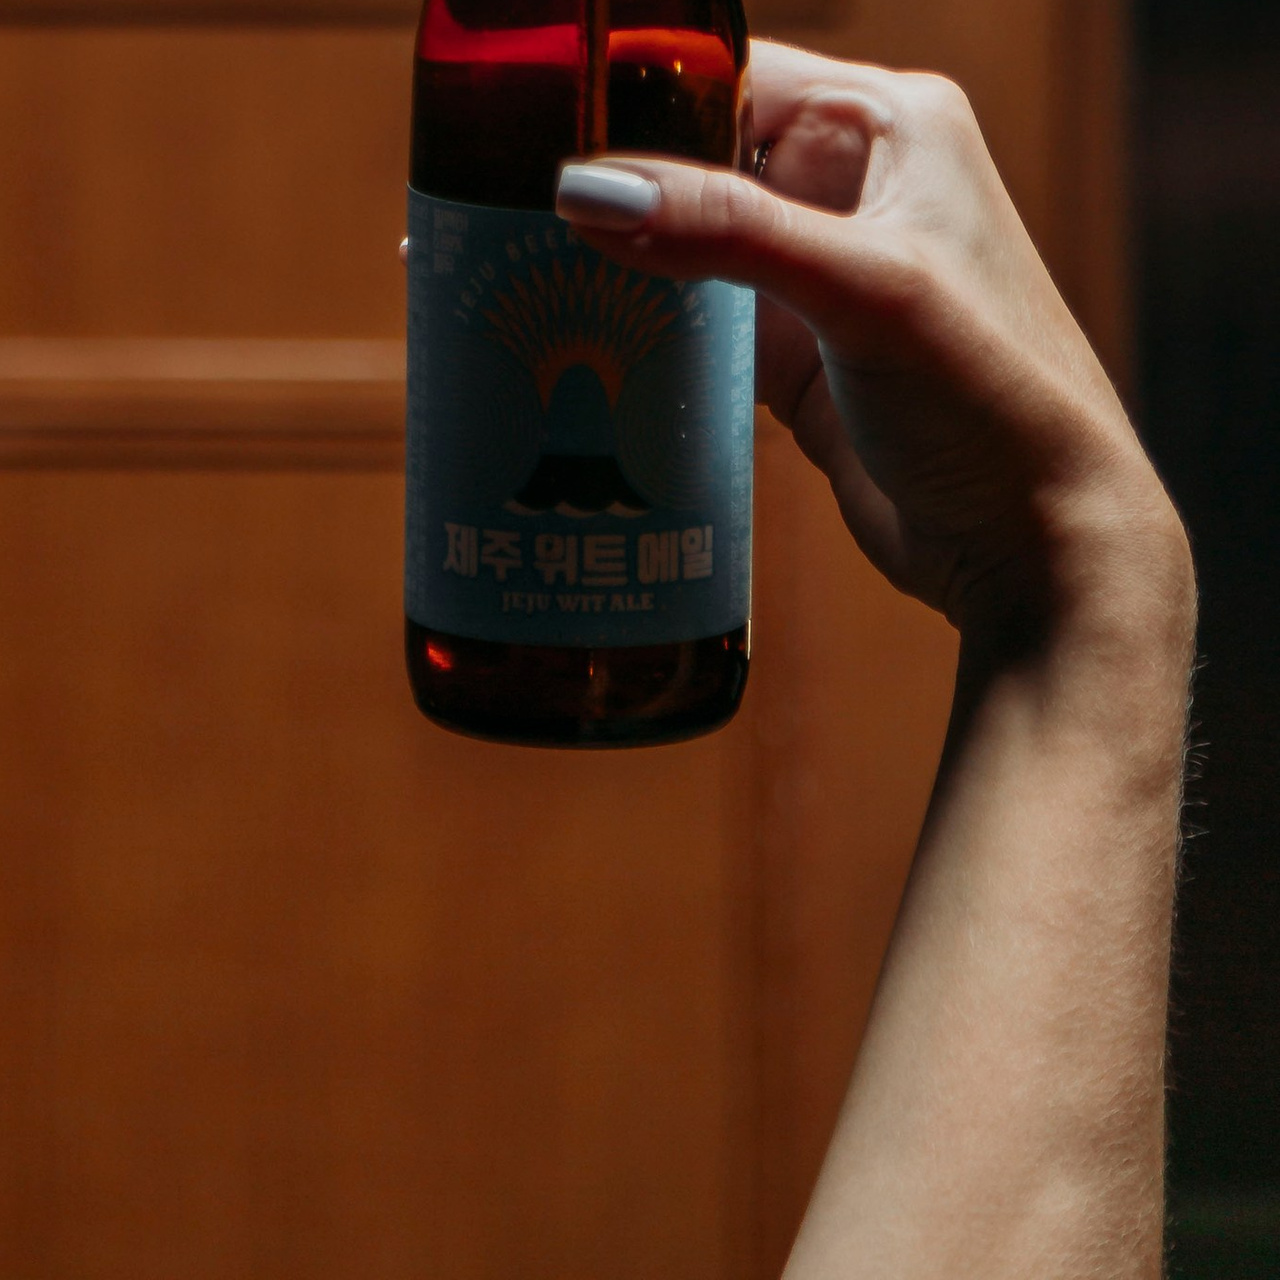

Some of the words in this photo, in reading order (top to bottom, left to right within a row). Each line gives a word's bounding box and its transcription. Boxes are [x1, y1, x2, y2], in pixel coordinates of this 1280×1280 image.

[442, 521, 524, 582] 제주
[532, 532, 629, 586] 위트
[636, 523, 715, 585] 에일
[502, 591, 551, 614] JEJU
[556, 592, 606, 613] WIT
[609, 592, 656, 612] ALE
